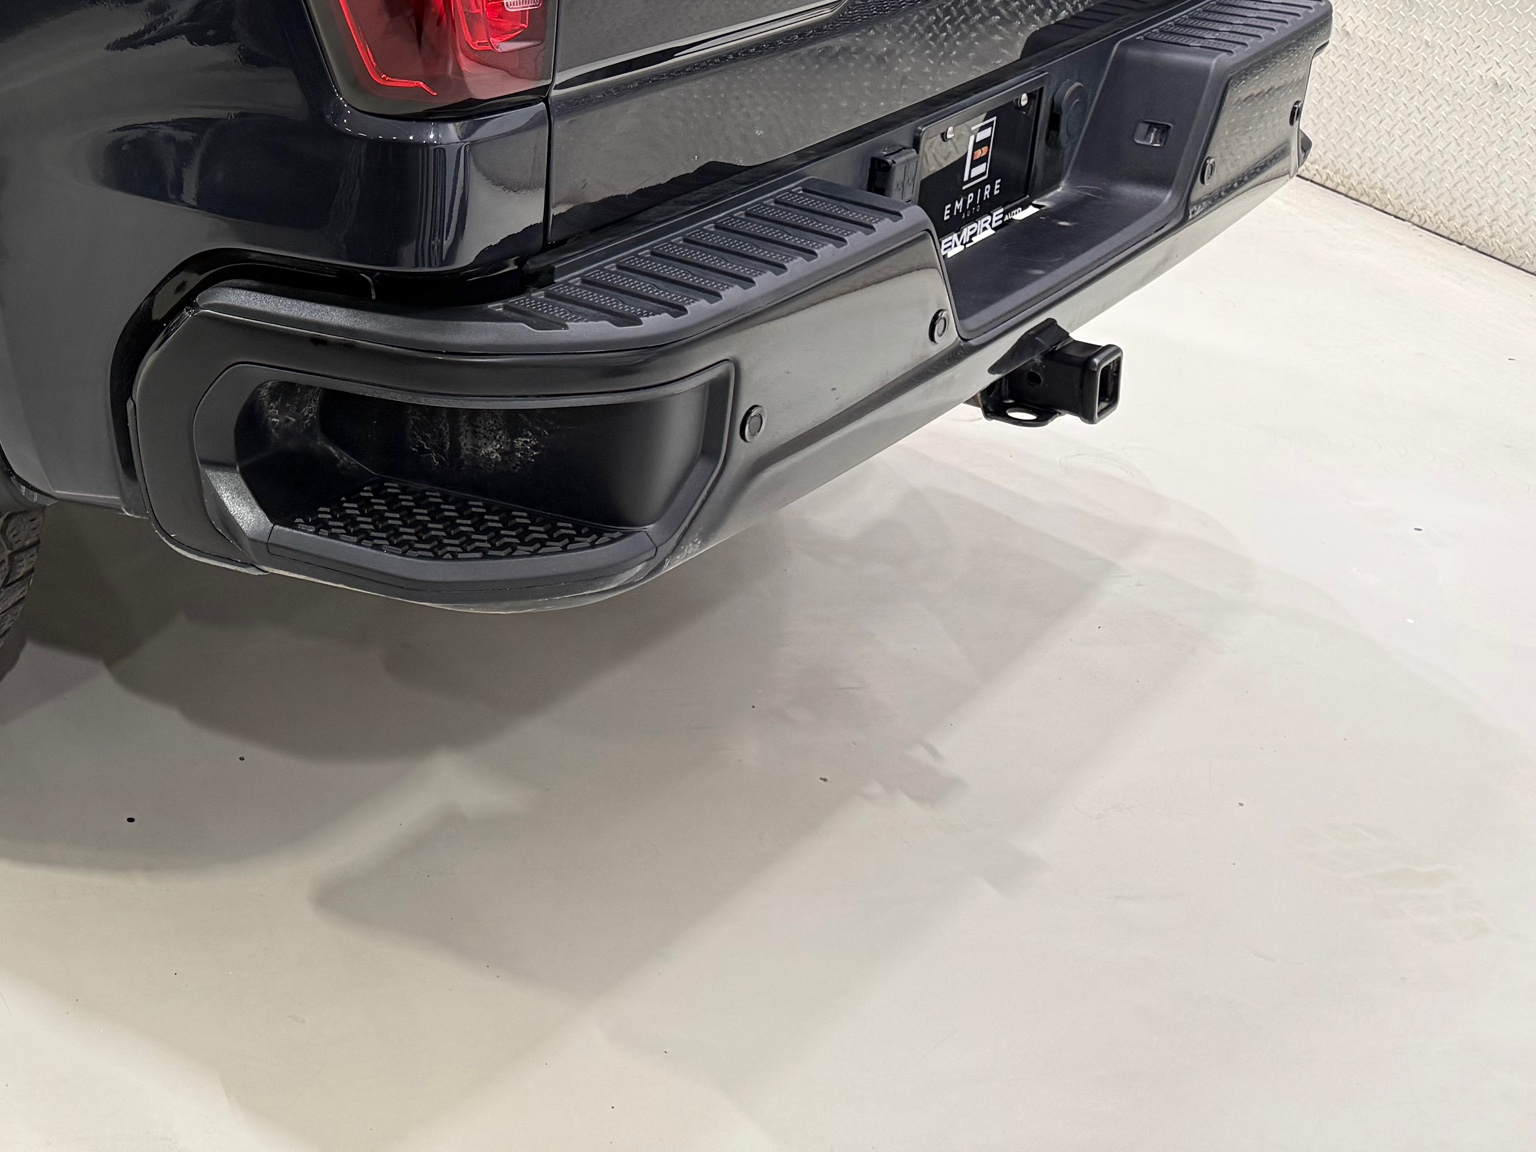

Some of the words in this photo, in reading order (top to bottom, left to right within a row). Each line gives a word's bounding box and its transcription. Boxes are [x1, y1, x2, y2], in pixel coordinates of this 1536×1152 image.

[944, 179, 1002, 221] EMPIRE
[962, 205, 981, 219] AUTO
[1003, 207, 1023, 222] AUTO
[940, 207, 1004, 256] EMPIRE
